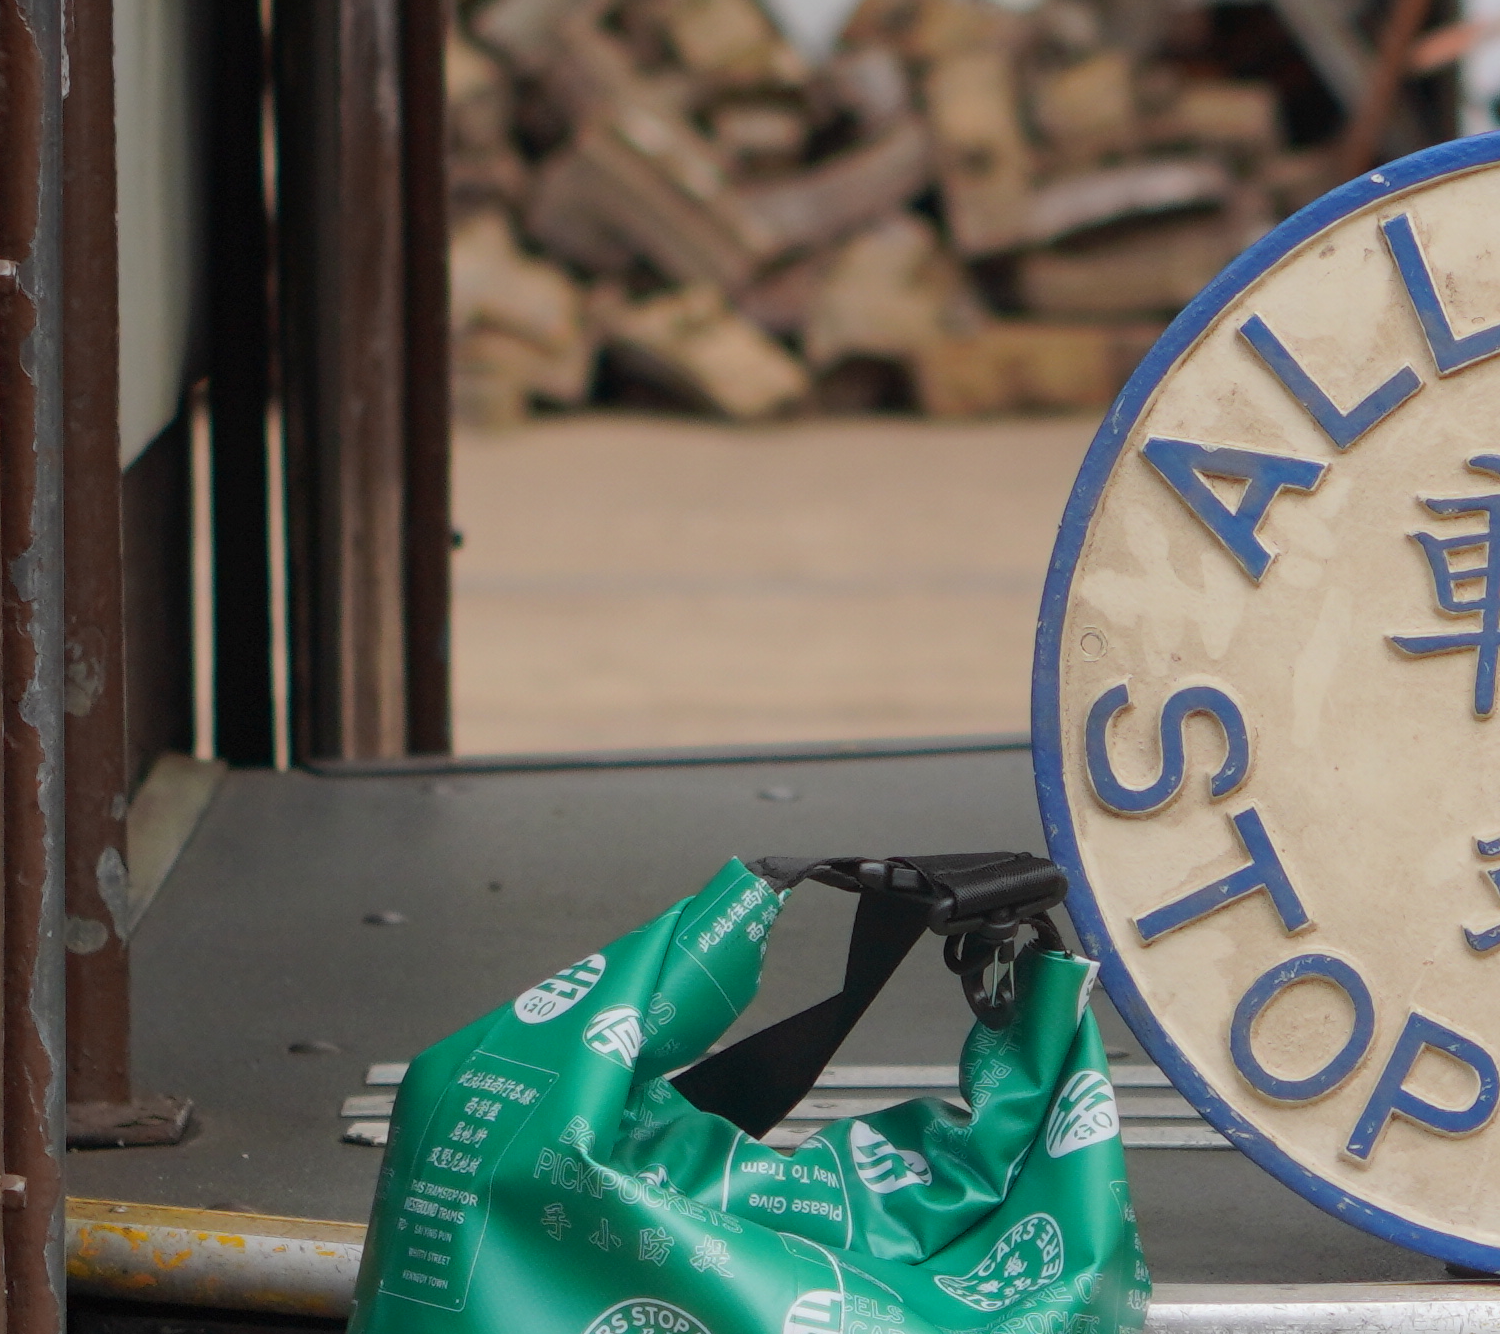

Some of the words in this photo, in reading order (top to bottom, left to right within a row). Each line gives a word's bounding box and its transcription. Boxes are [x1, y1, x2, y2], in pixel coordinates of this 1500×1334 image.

[741, 1161, 786, 1181] Tram
[792, 1165, 810, 1183] To
[813, 1165, 839, 1189] Way
[534, 1147, 743, 1234] PICKPOCKETS
[749, 1194, 786, 1214] Give
[792, 1199, 842, 1221] Please
[631, 1307, 689, 1333] STOP
